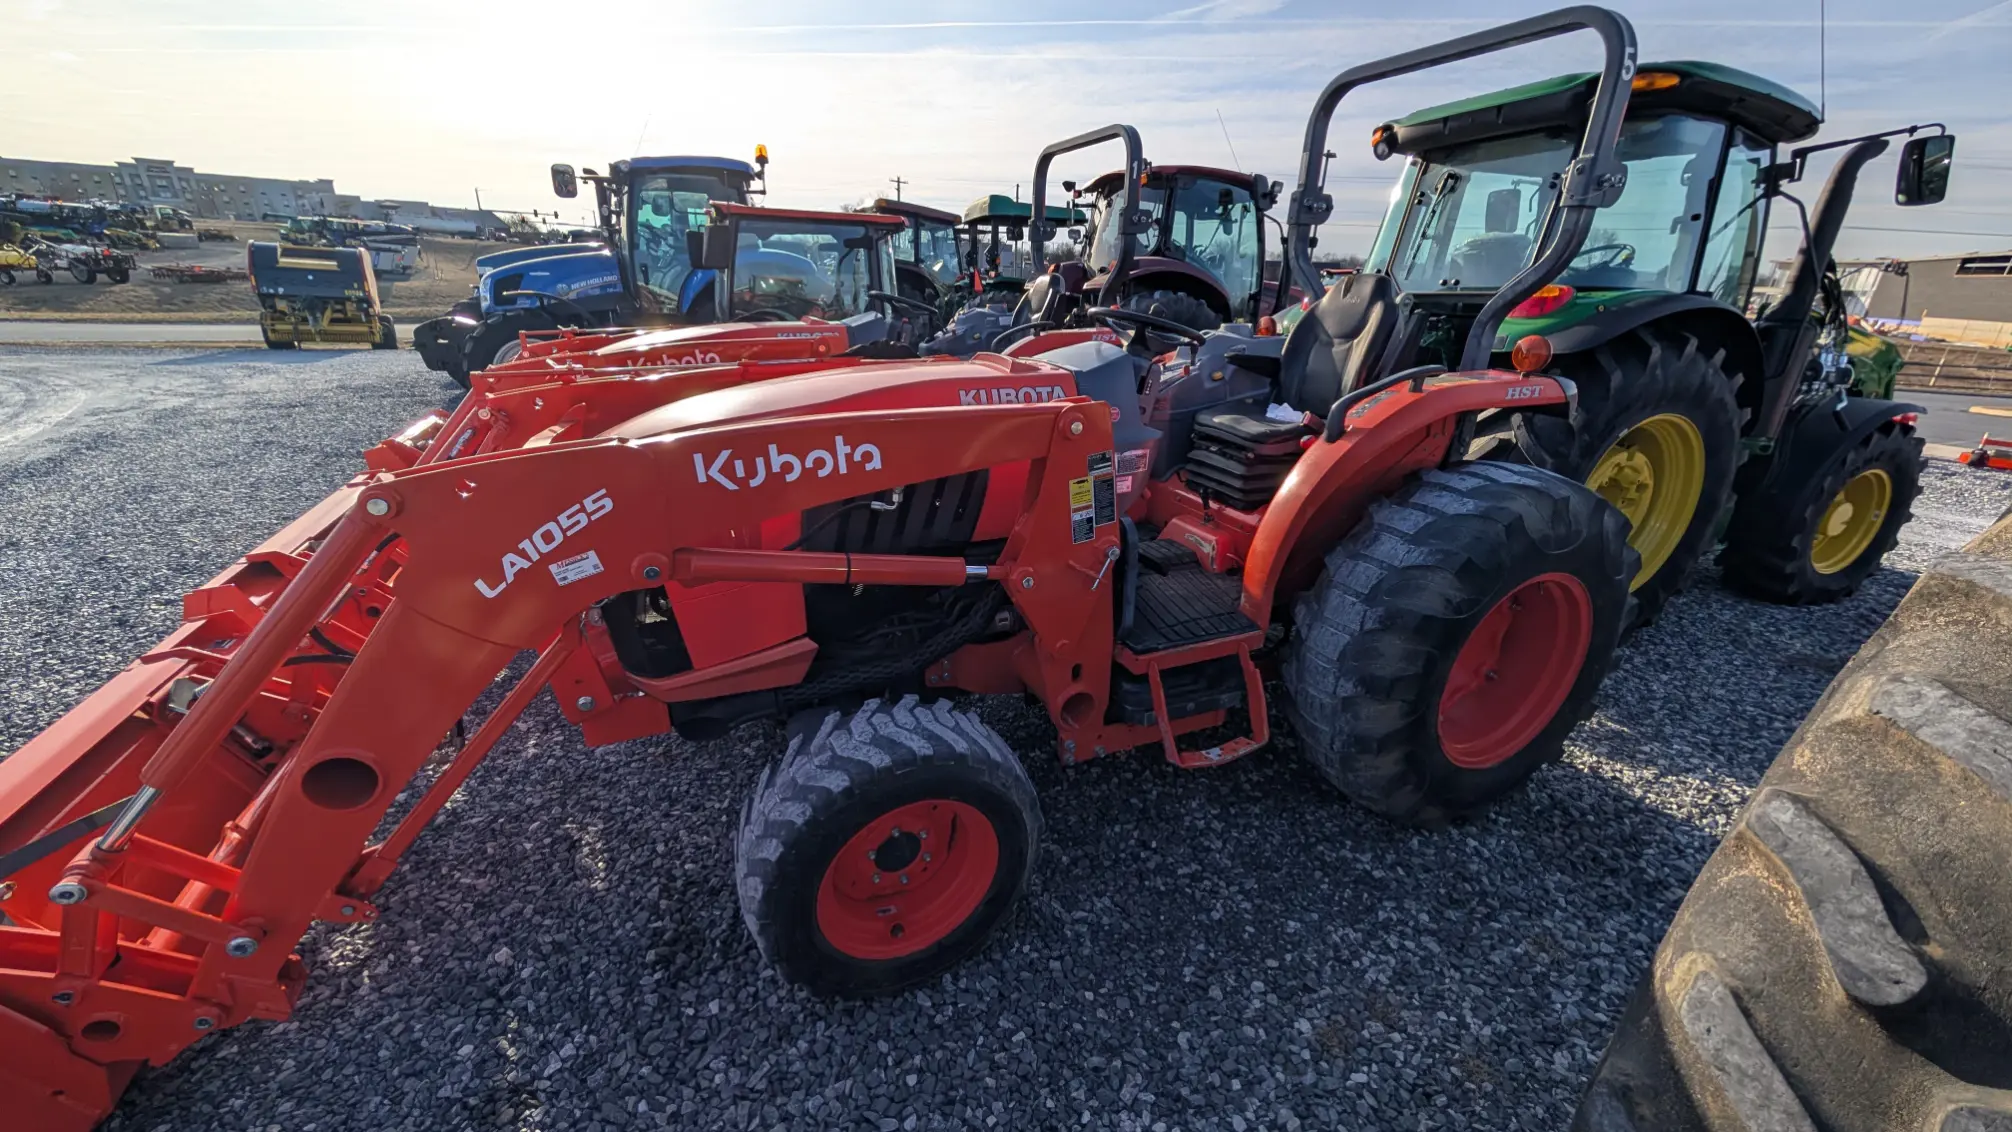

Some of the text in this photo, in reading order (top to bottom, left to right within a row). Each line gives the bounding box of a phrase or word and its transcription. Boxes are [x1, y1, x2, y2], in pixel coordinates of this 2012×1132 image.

[1622, 46, 1635, 81] 5
[571, 275, 618, 290] NEW HOLLAND
[626, 348, 720, 377] Kbota
[958, 385, 1067, 406] KUBOTA
[1505, 385, 1544, 399] HST
[693, 435, 882, 490] Kubota
[473, 488, 614, 599] LA1055
